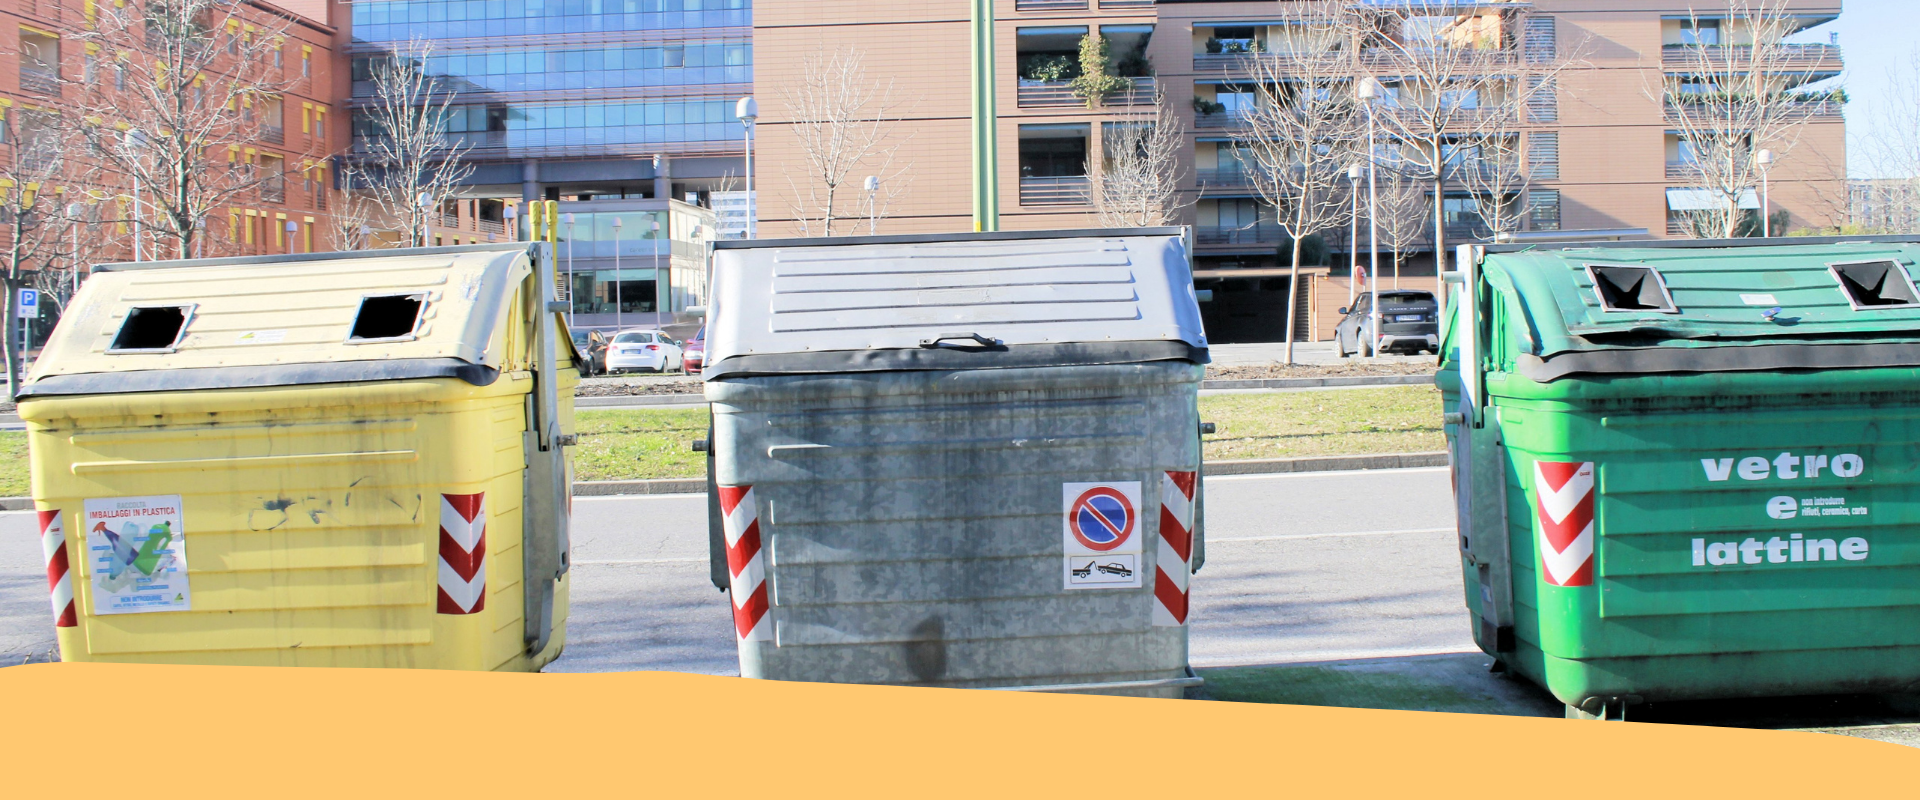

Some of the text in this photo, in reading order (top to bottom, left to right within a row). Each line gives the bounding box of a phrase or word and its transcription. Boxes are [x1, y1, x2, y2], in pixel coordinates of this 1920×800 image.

[23, 292, 34, 304] P
[1701, 452, 1864, 481] vetro
[90, 509, 131, 519] IMBALLAGGI
[142, 507, 175, 516] PLASTICA
[1766, 495, 1798, 519] e
[1691, 533, 1869, 566] lattine
